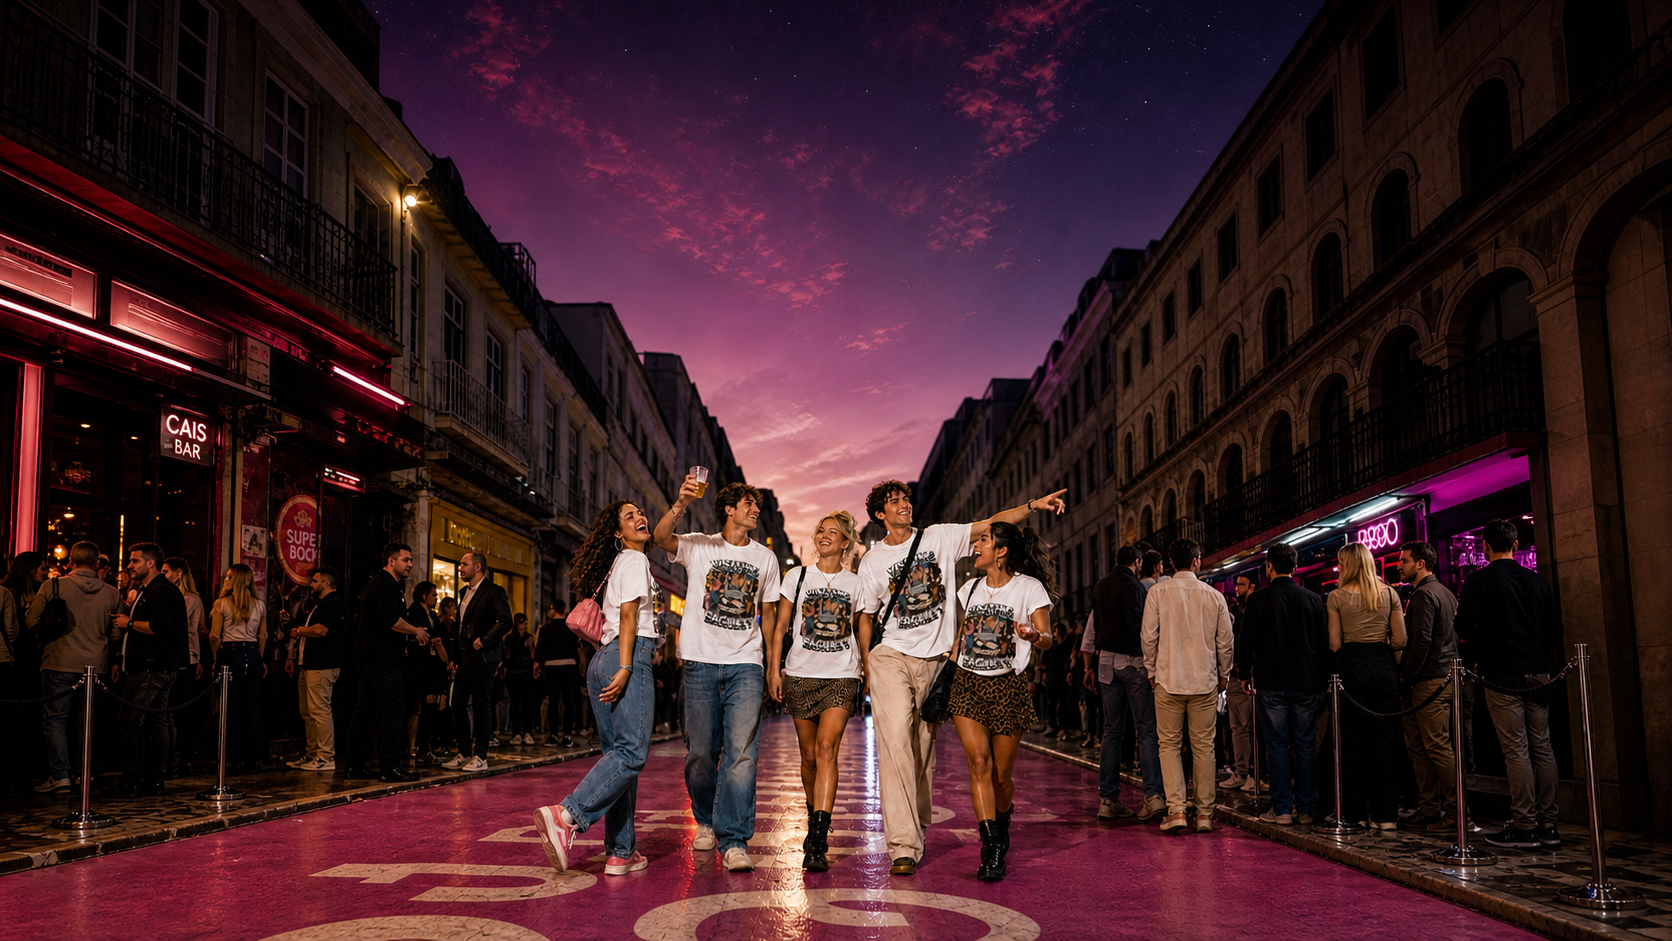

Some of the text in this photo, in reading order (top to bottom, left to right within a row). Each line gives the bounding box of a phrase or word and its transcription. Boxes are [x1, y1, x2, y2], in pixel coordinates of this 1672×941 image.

[166, 414, 207, 442] CAIS
[174, 438, 201, 460] BAR
[286, 528, 317, 547] SUPE
[289, 544, 318, 562] BOCK
